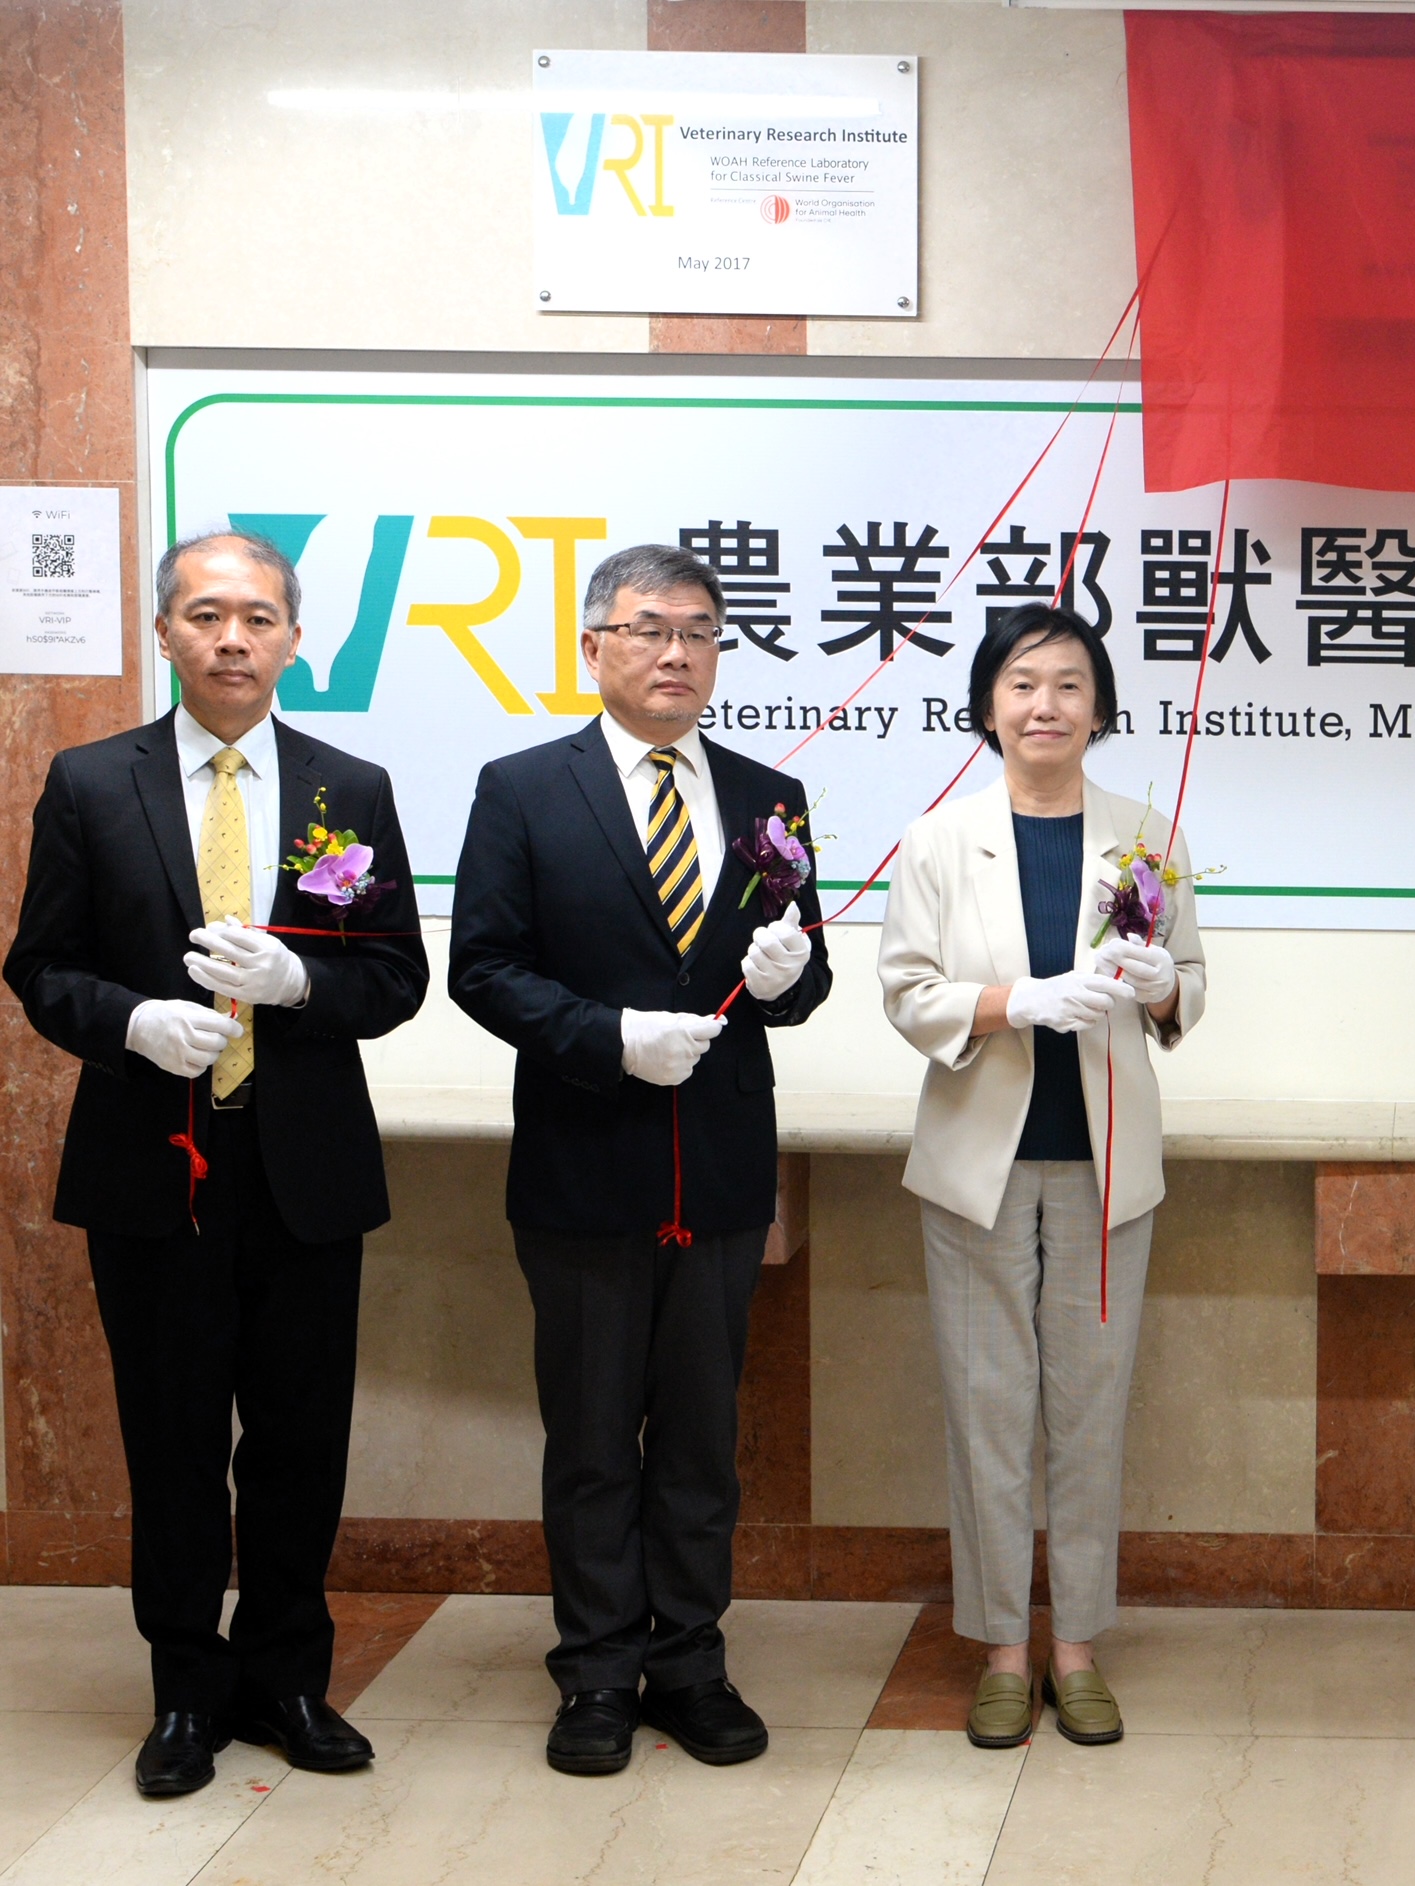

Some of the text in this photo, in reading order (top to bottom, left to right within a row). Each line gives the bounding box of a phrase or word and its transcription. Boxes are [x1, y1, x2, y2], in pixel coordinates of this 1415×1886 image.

[680, 126, 908, 143] Veterinary Research Institute
[540, 112, 675, 217] VRI
[710, 156, 869, 171] WOAH Reference Laboratory
[710, 171, 855, 184] for Classical Swine Fever
[795, 199, 875, 208] World Organisation
[795, 208, 866, 217] for Animal Health
[678, 256, 751, 272] May 2017
[45, 510, 71, 520] WiFi
[38, 616, 72, 624] VRI-VIP
[227, 513, 607, 716] VRI
[698, 696, 898, 739] eterinary
[1158, 701, 1352, 741] Institute,
